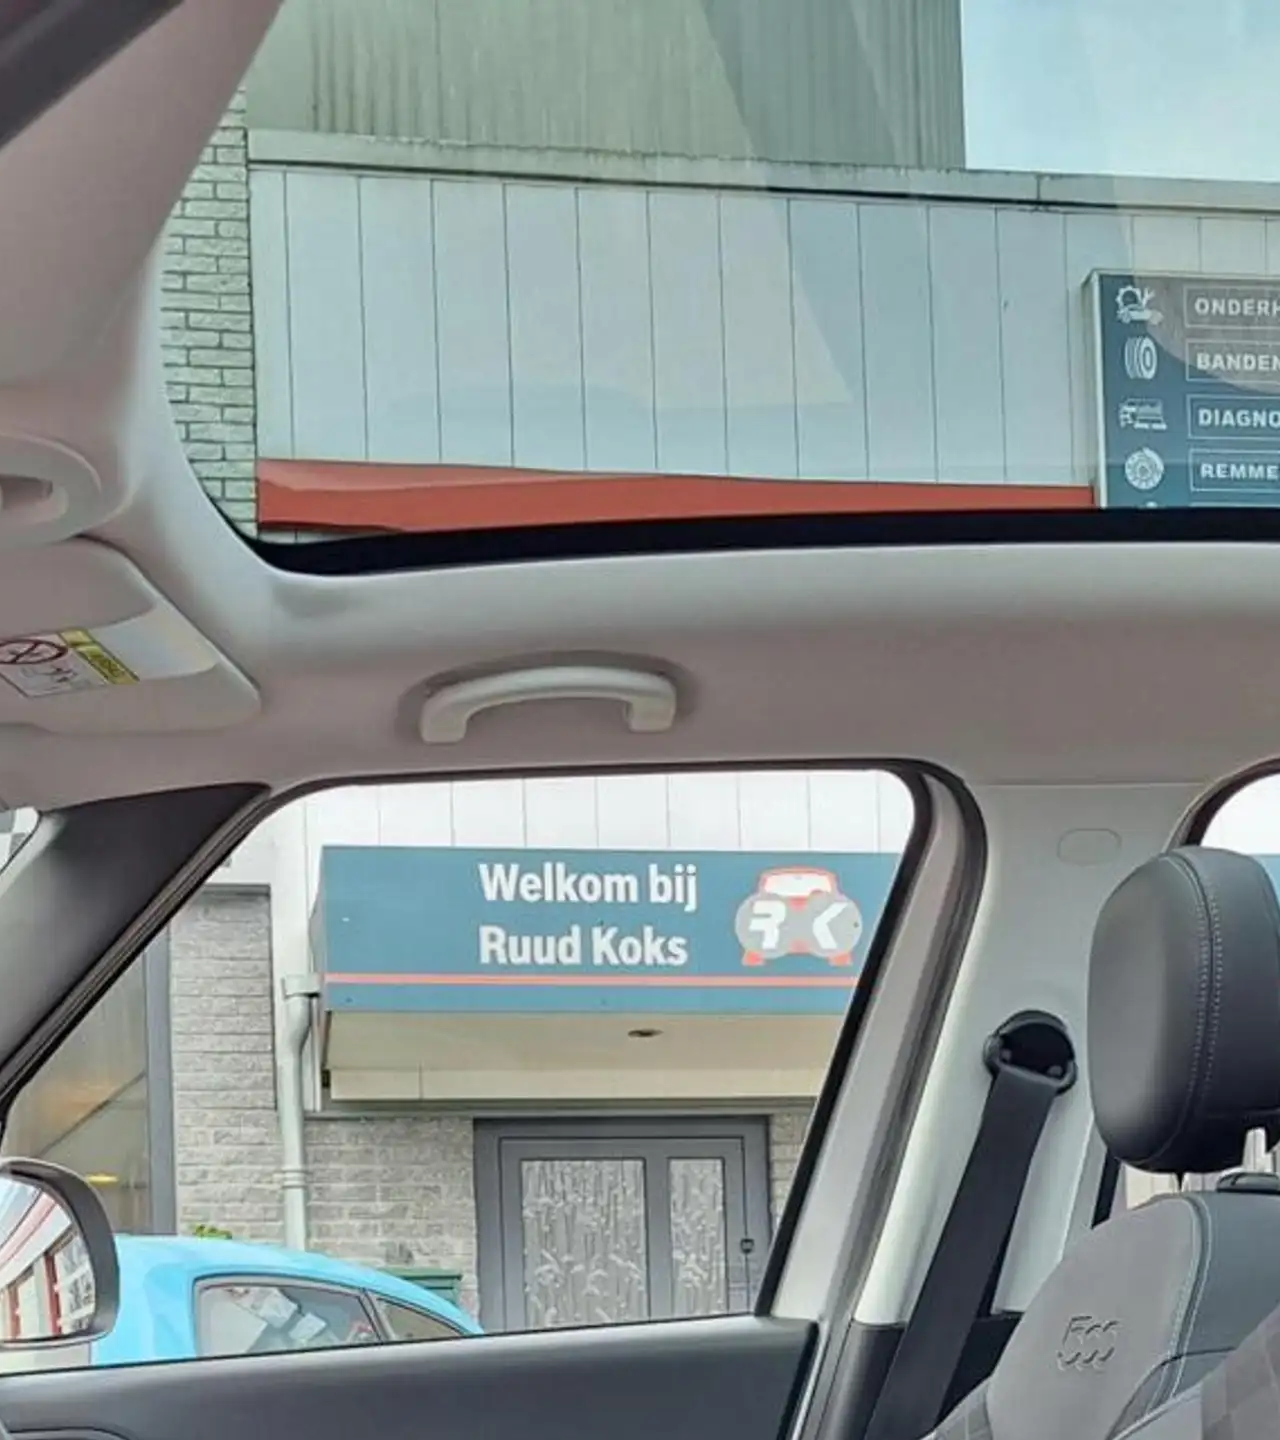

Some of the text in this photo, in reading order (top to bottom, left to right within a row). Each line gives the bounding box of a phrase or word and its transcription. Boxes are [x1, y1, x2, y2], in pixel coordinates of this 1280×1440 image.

[479, 863, 698, 912] Welkom bij
[479, 926, 689, 966] Ruud Koks
